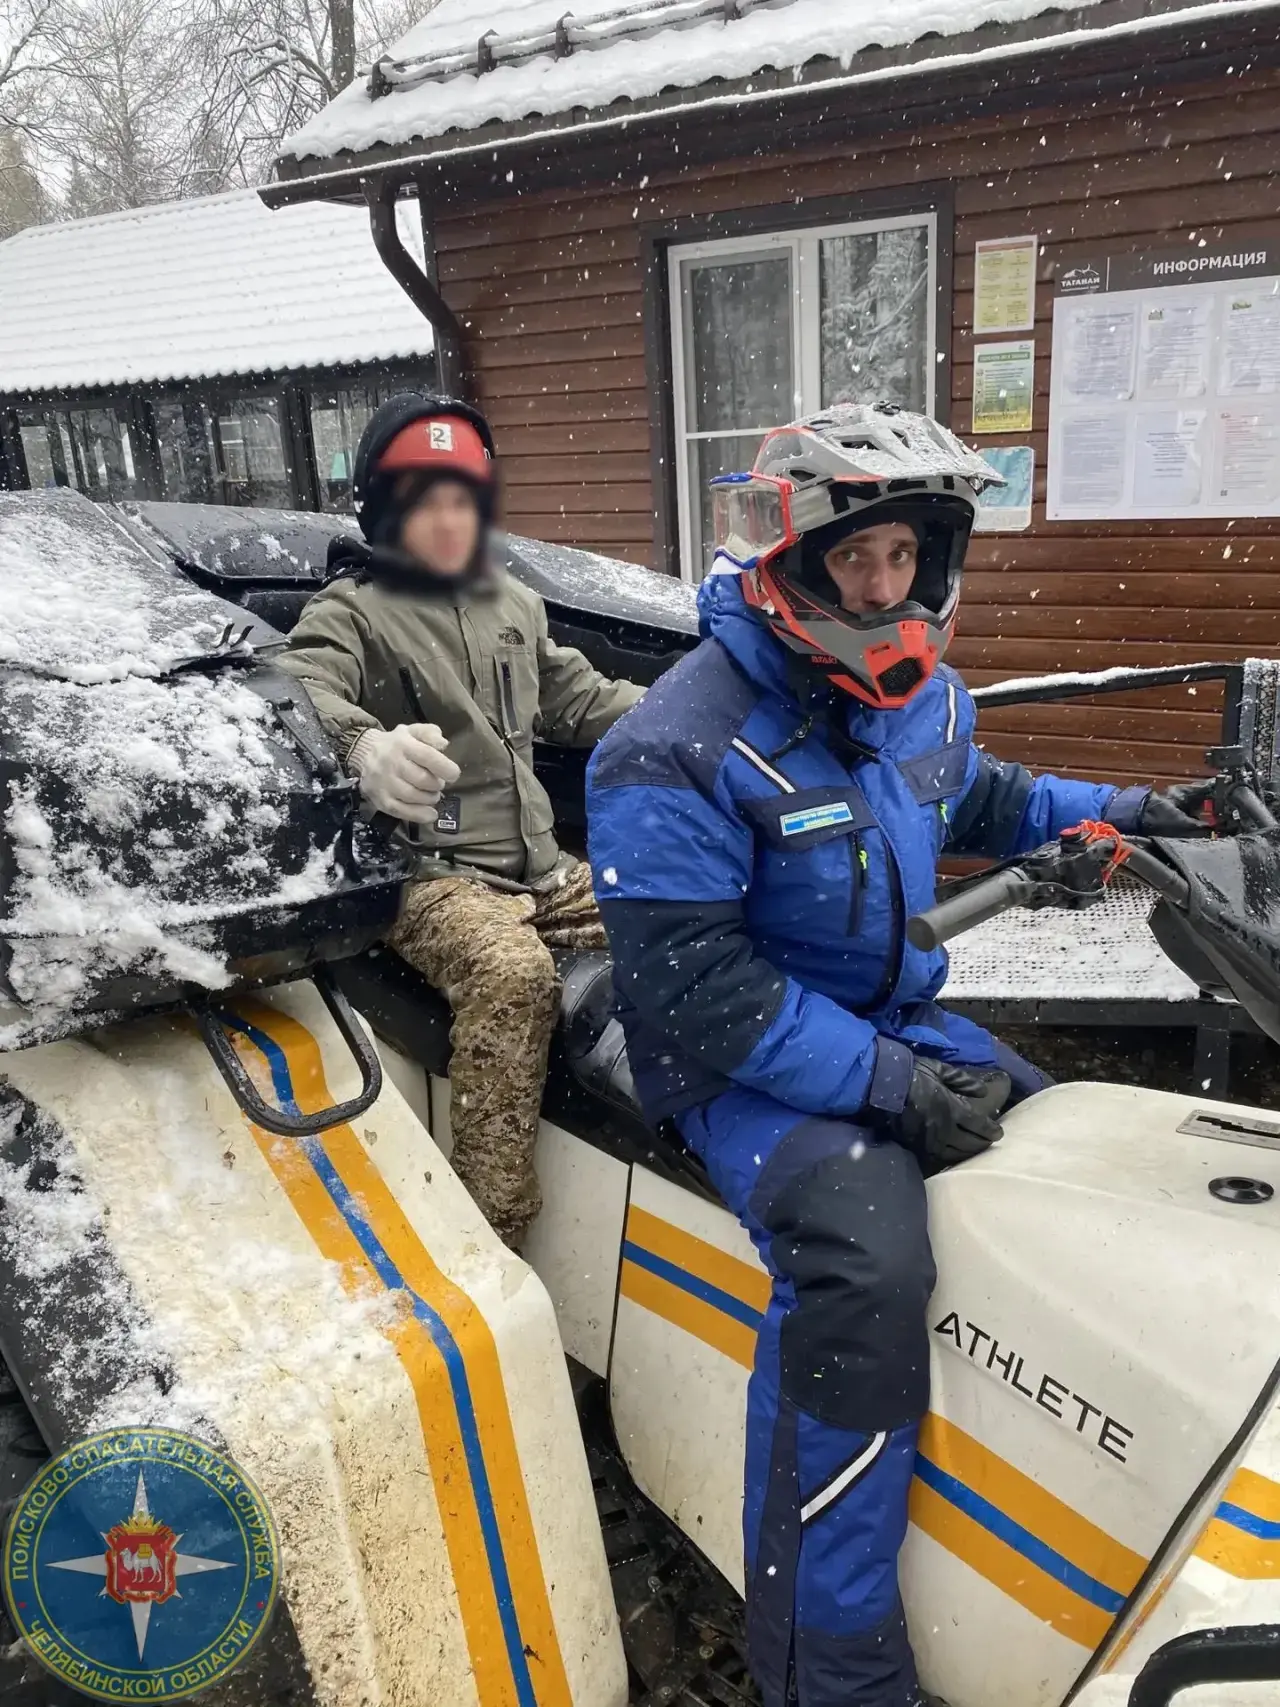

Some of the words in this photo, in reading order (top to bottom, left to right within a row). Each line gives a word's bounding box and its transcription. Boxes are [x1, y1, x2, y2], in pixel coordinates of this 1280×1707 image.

[1153, 251, 1267, 275] ИНФОРМАЦИЯ
[432, 427, 446, 443] 2
[933, 1311, 1134, 1463] ATHLETE
